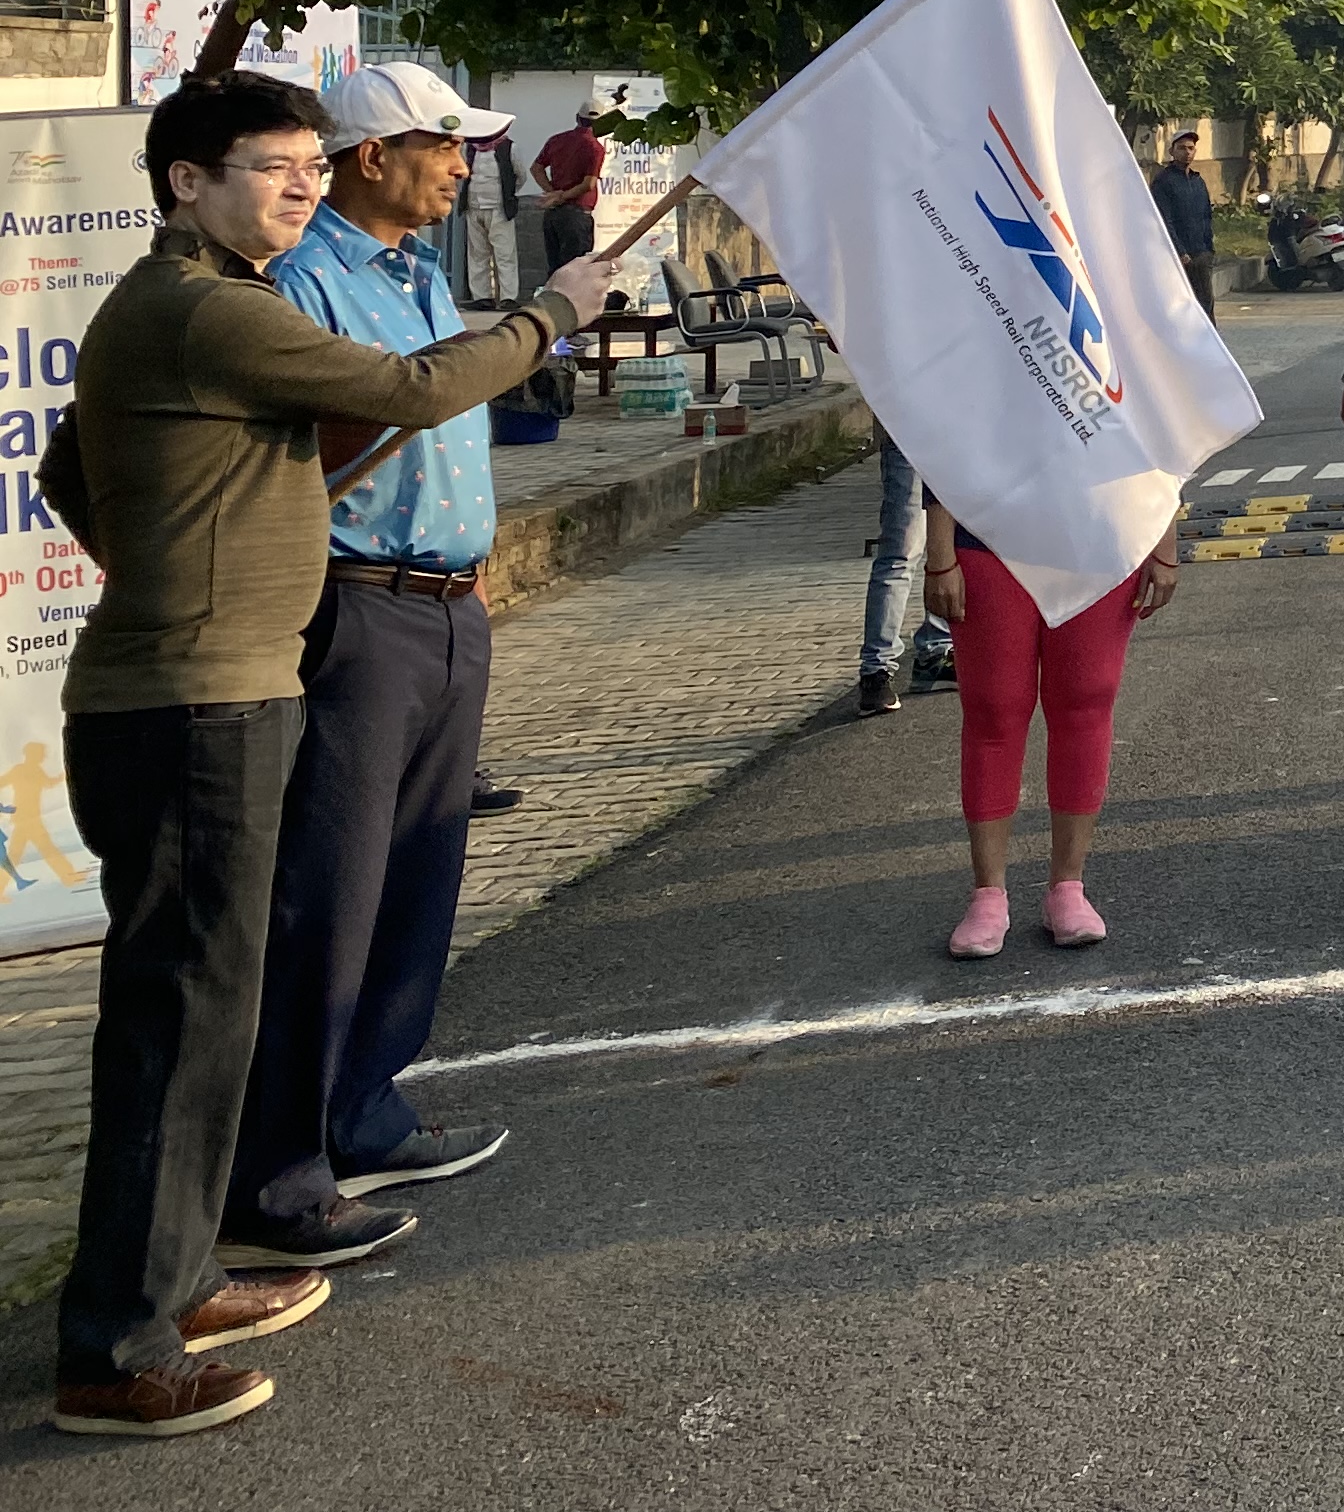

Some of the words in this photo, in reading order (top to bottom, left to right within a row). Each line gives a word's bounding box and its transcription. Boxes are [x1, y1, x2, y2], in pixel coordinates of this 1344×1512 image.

[623, 157, 651, 174] and
[0, 207, 166, 238] Awareness
[0, 277, 41, 296] @75
[46, 273, 78, 291] Self
[911, 188, 960, 246] National
[951, 244, 979, 277] High
[974, 276, 1008, 317] Speed
[1001, 316, 1025, 346] Rail
[1018, 344, 1075, 422] Corporation
[1070, 417, 1096, 445] Ltd.
[1023, 315, 1112, 432] NHSRCL
[36, 563, 84, 592] Oct
[6, 629, 68, 655] Speed
